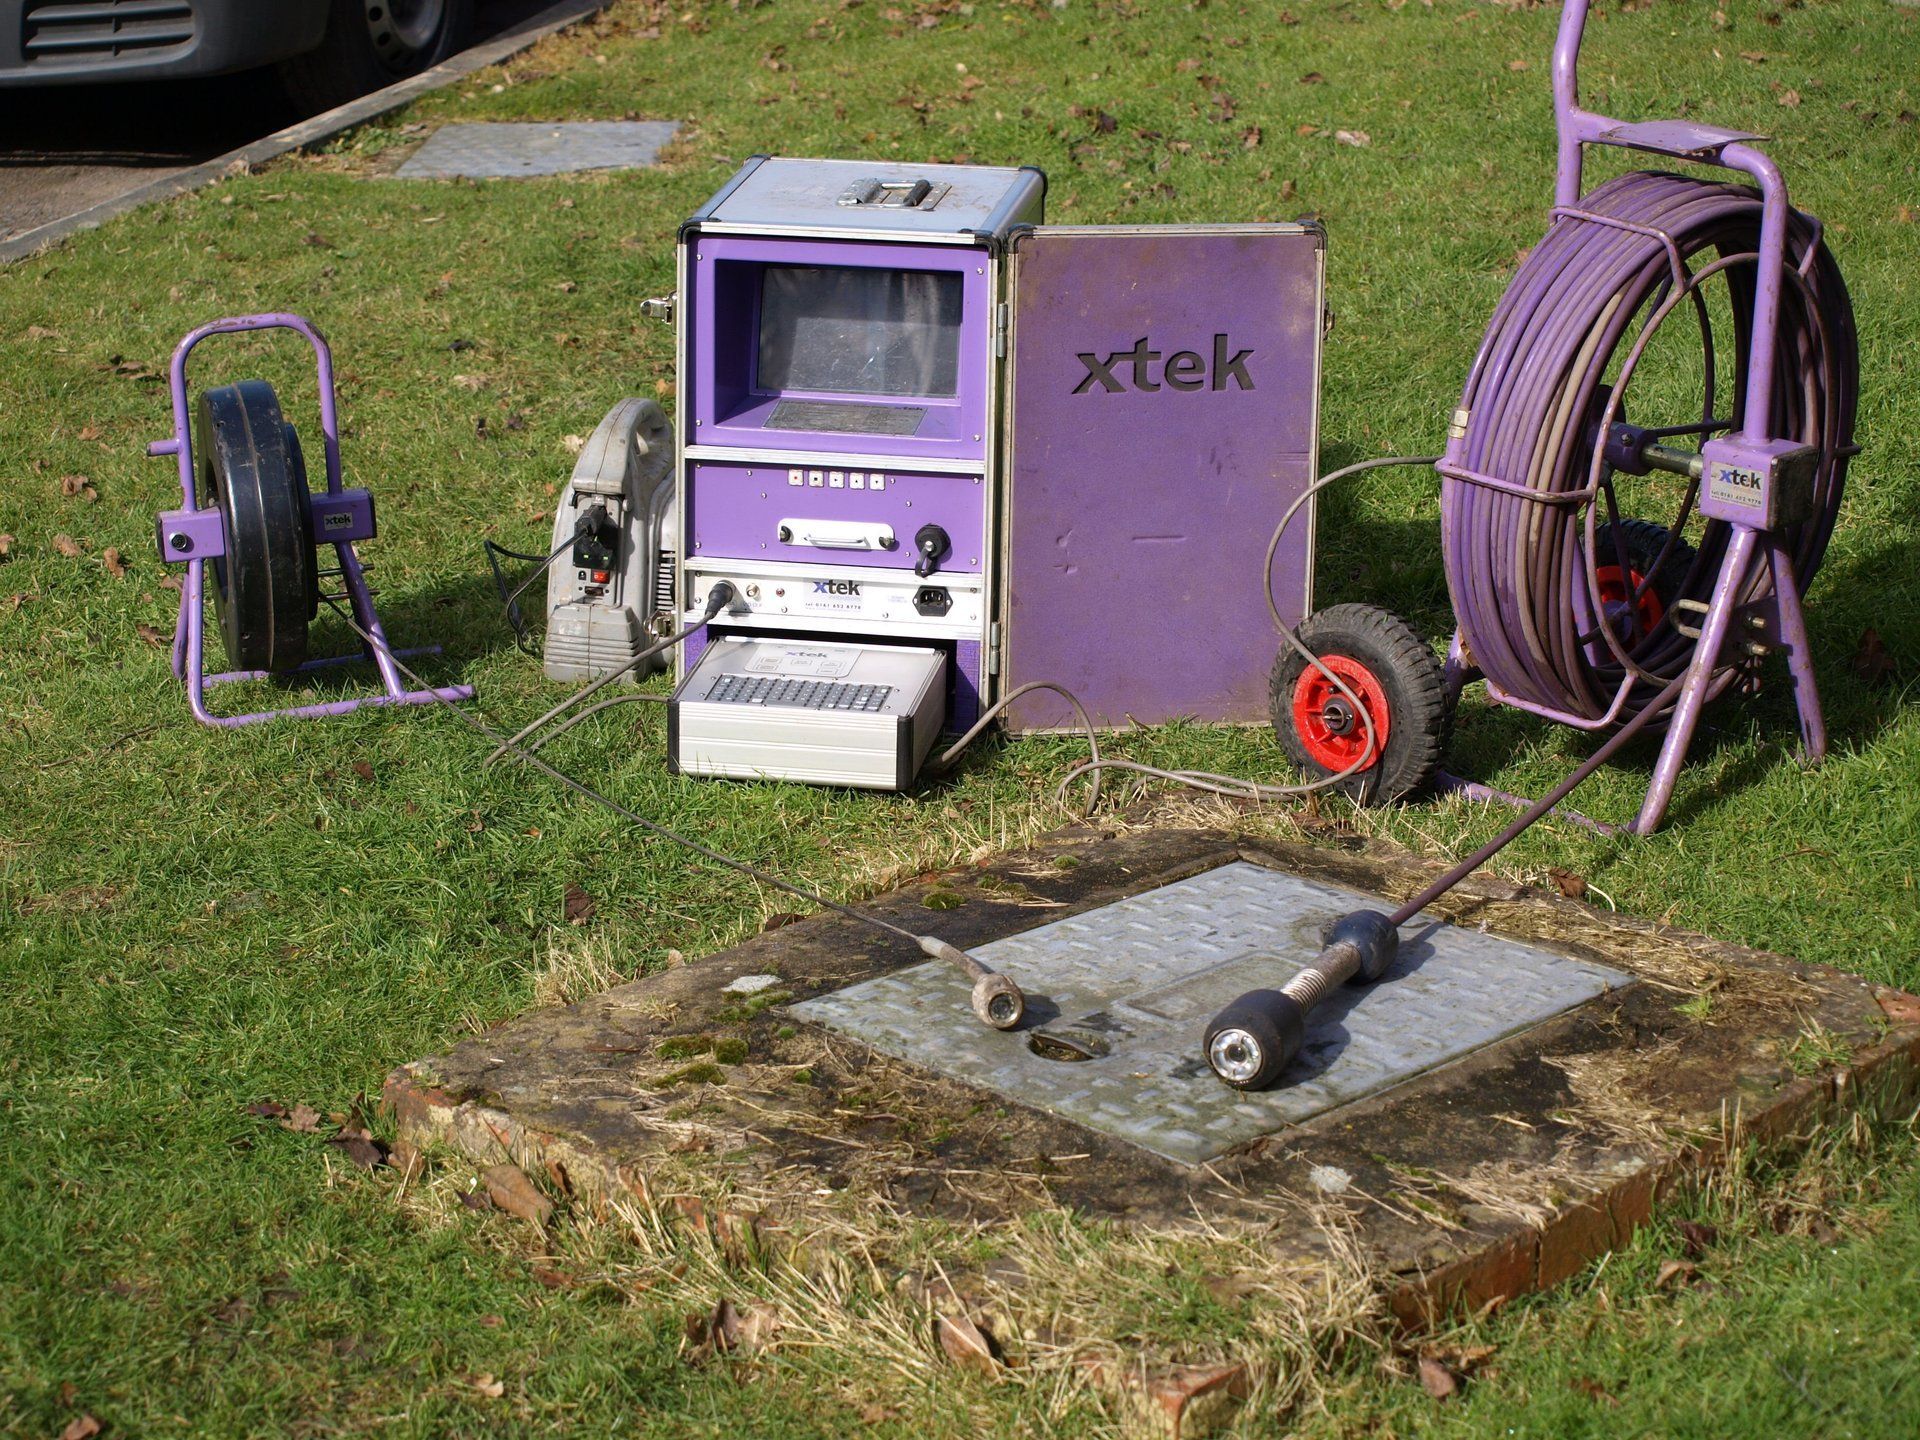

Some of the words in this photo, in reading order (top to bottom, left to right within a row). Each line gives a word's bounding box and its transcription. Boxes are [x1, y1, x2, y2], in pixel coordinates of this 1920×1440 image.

[1071, 333, 1256, 395] xtek
[1719, 469, 1761, 490] xtek
[325, 514, 351, 525] xtek
[813, 579, 861, 596] xtek
